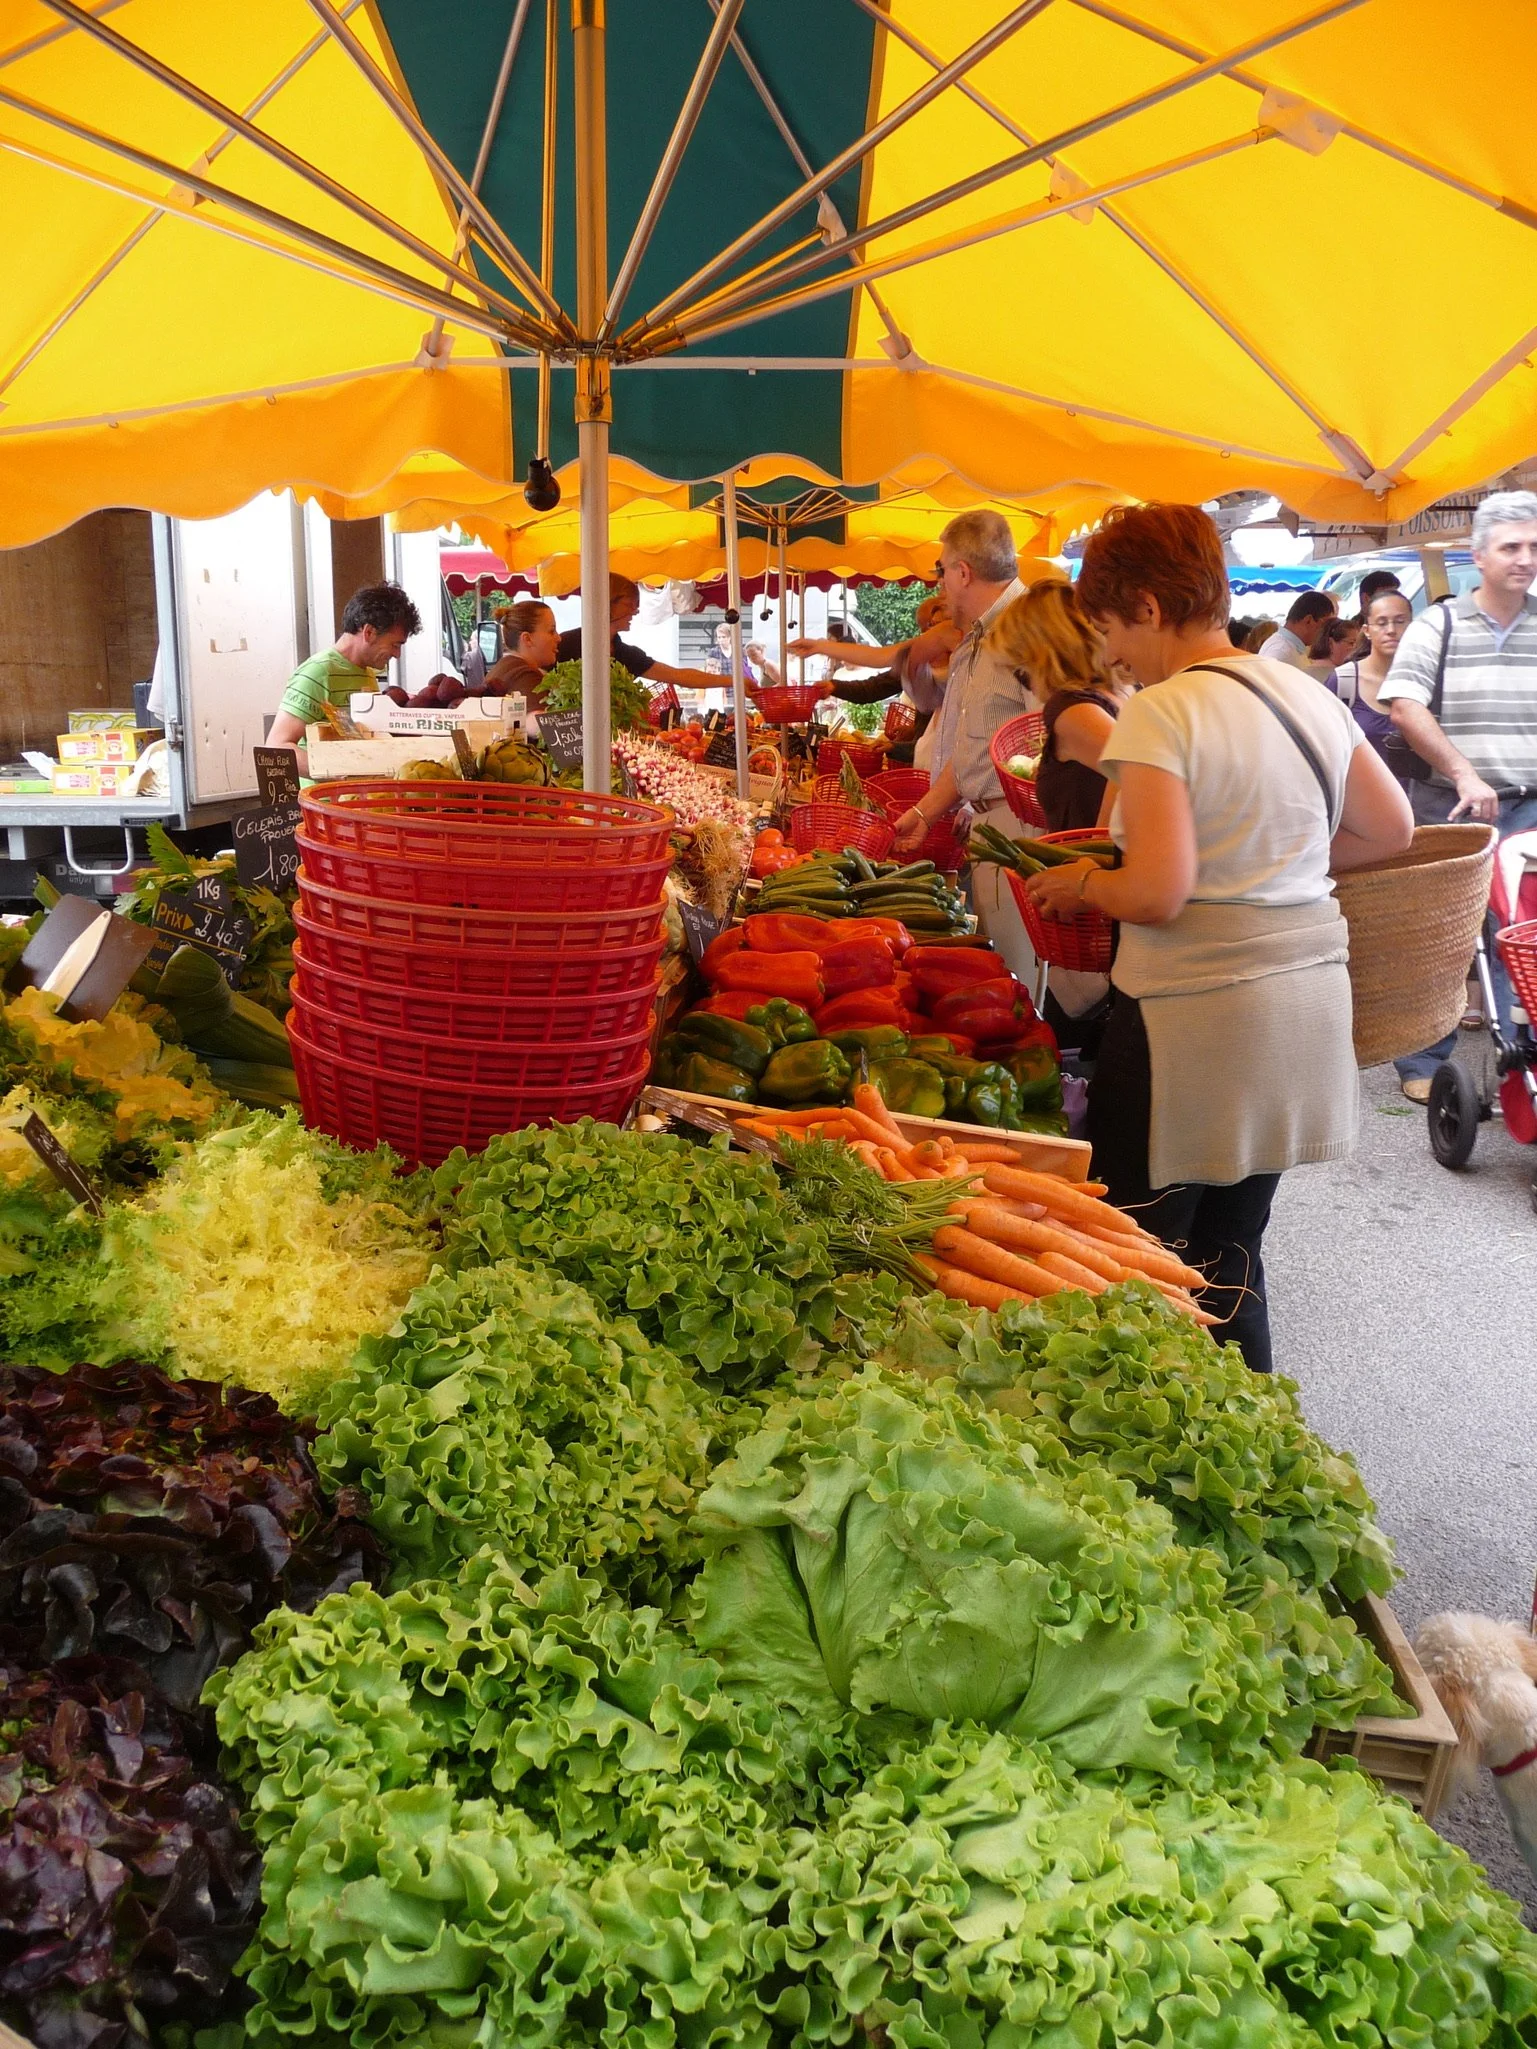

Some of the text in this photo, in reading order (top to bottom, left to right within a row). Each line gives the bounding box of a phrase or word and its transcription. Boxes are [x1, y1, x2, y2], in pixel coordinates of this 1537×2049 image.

[389, 711, 422, 719] BETTERAVES
[389, 719, 458, 731] SARL RISS
[196, 878, 221, 900] 1Kg
[156, 902, 184, 931] Prix
